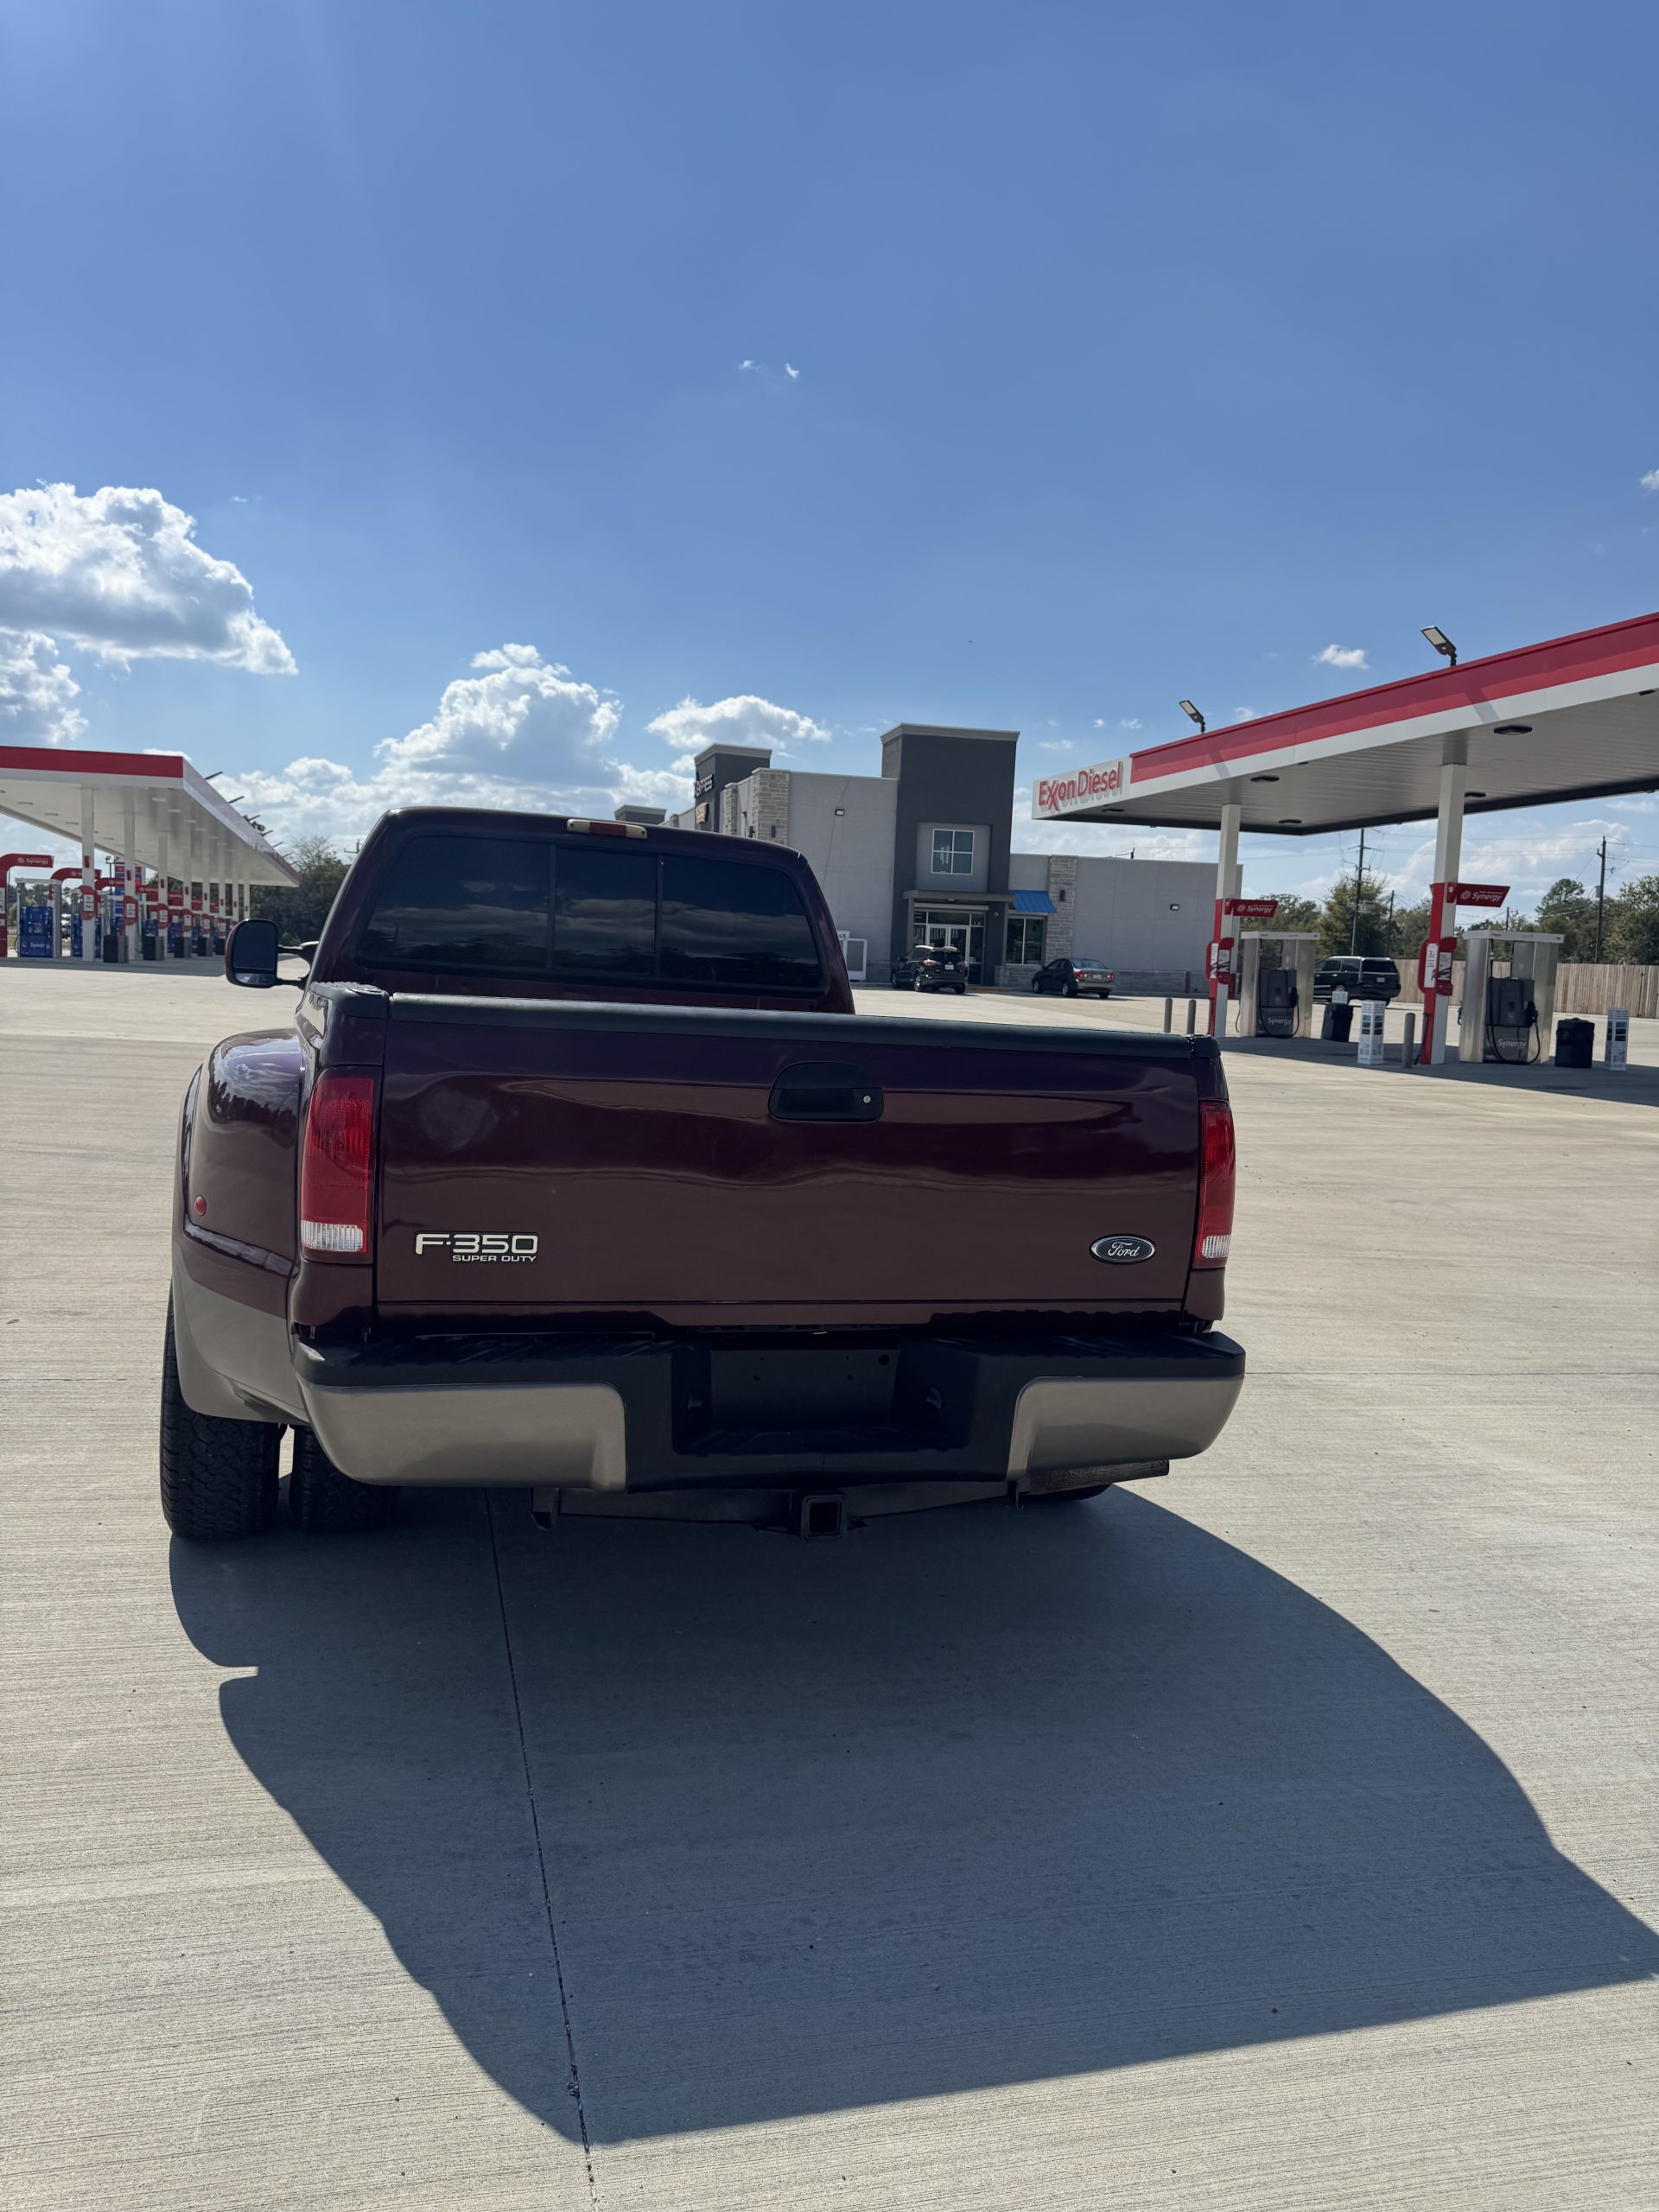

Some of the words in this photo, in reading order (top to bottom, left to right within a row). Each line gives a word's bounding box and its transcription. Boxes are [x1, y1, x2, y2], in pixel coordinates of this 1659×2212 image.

[1039, 779, 1075, 810] Exxon
[1077, 761, 1121, 797] Diesel
[1471, 893, 1503, 902] Synergy
[1246, 906, 1273, 914] Synergy
[1267, 1017, 1292, 1026] Synergy
[1497, 1039, 1527, 1049] Synergy
[1107, 1242, 1141, 1257] Ford
